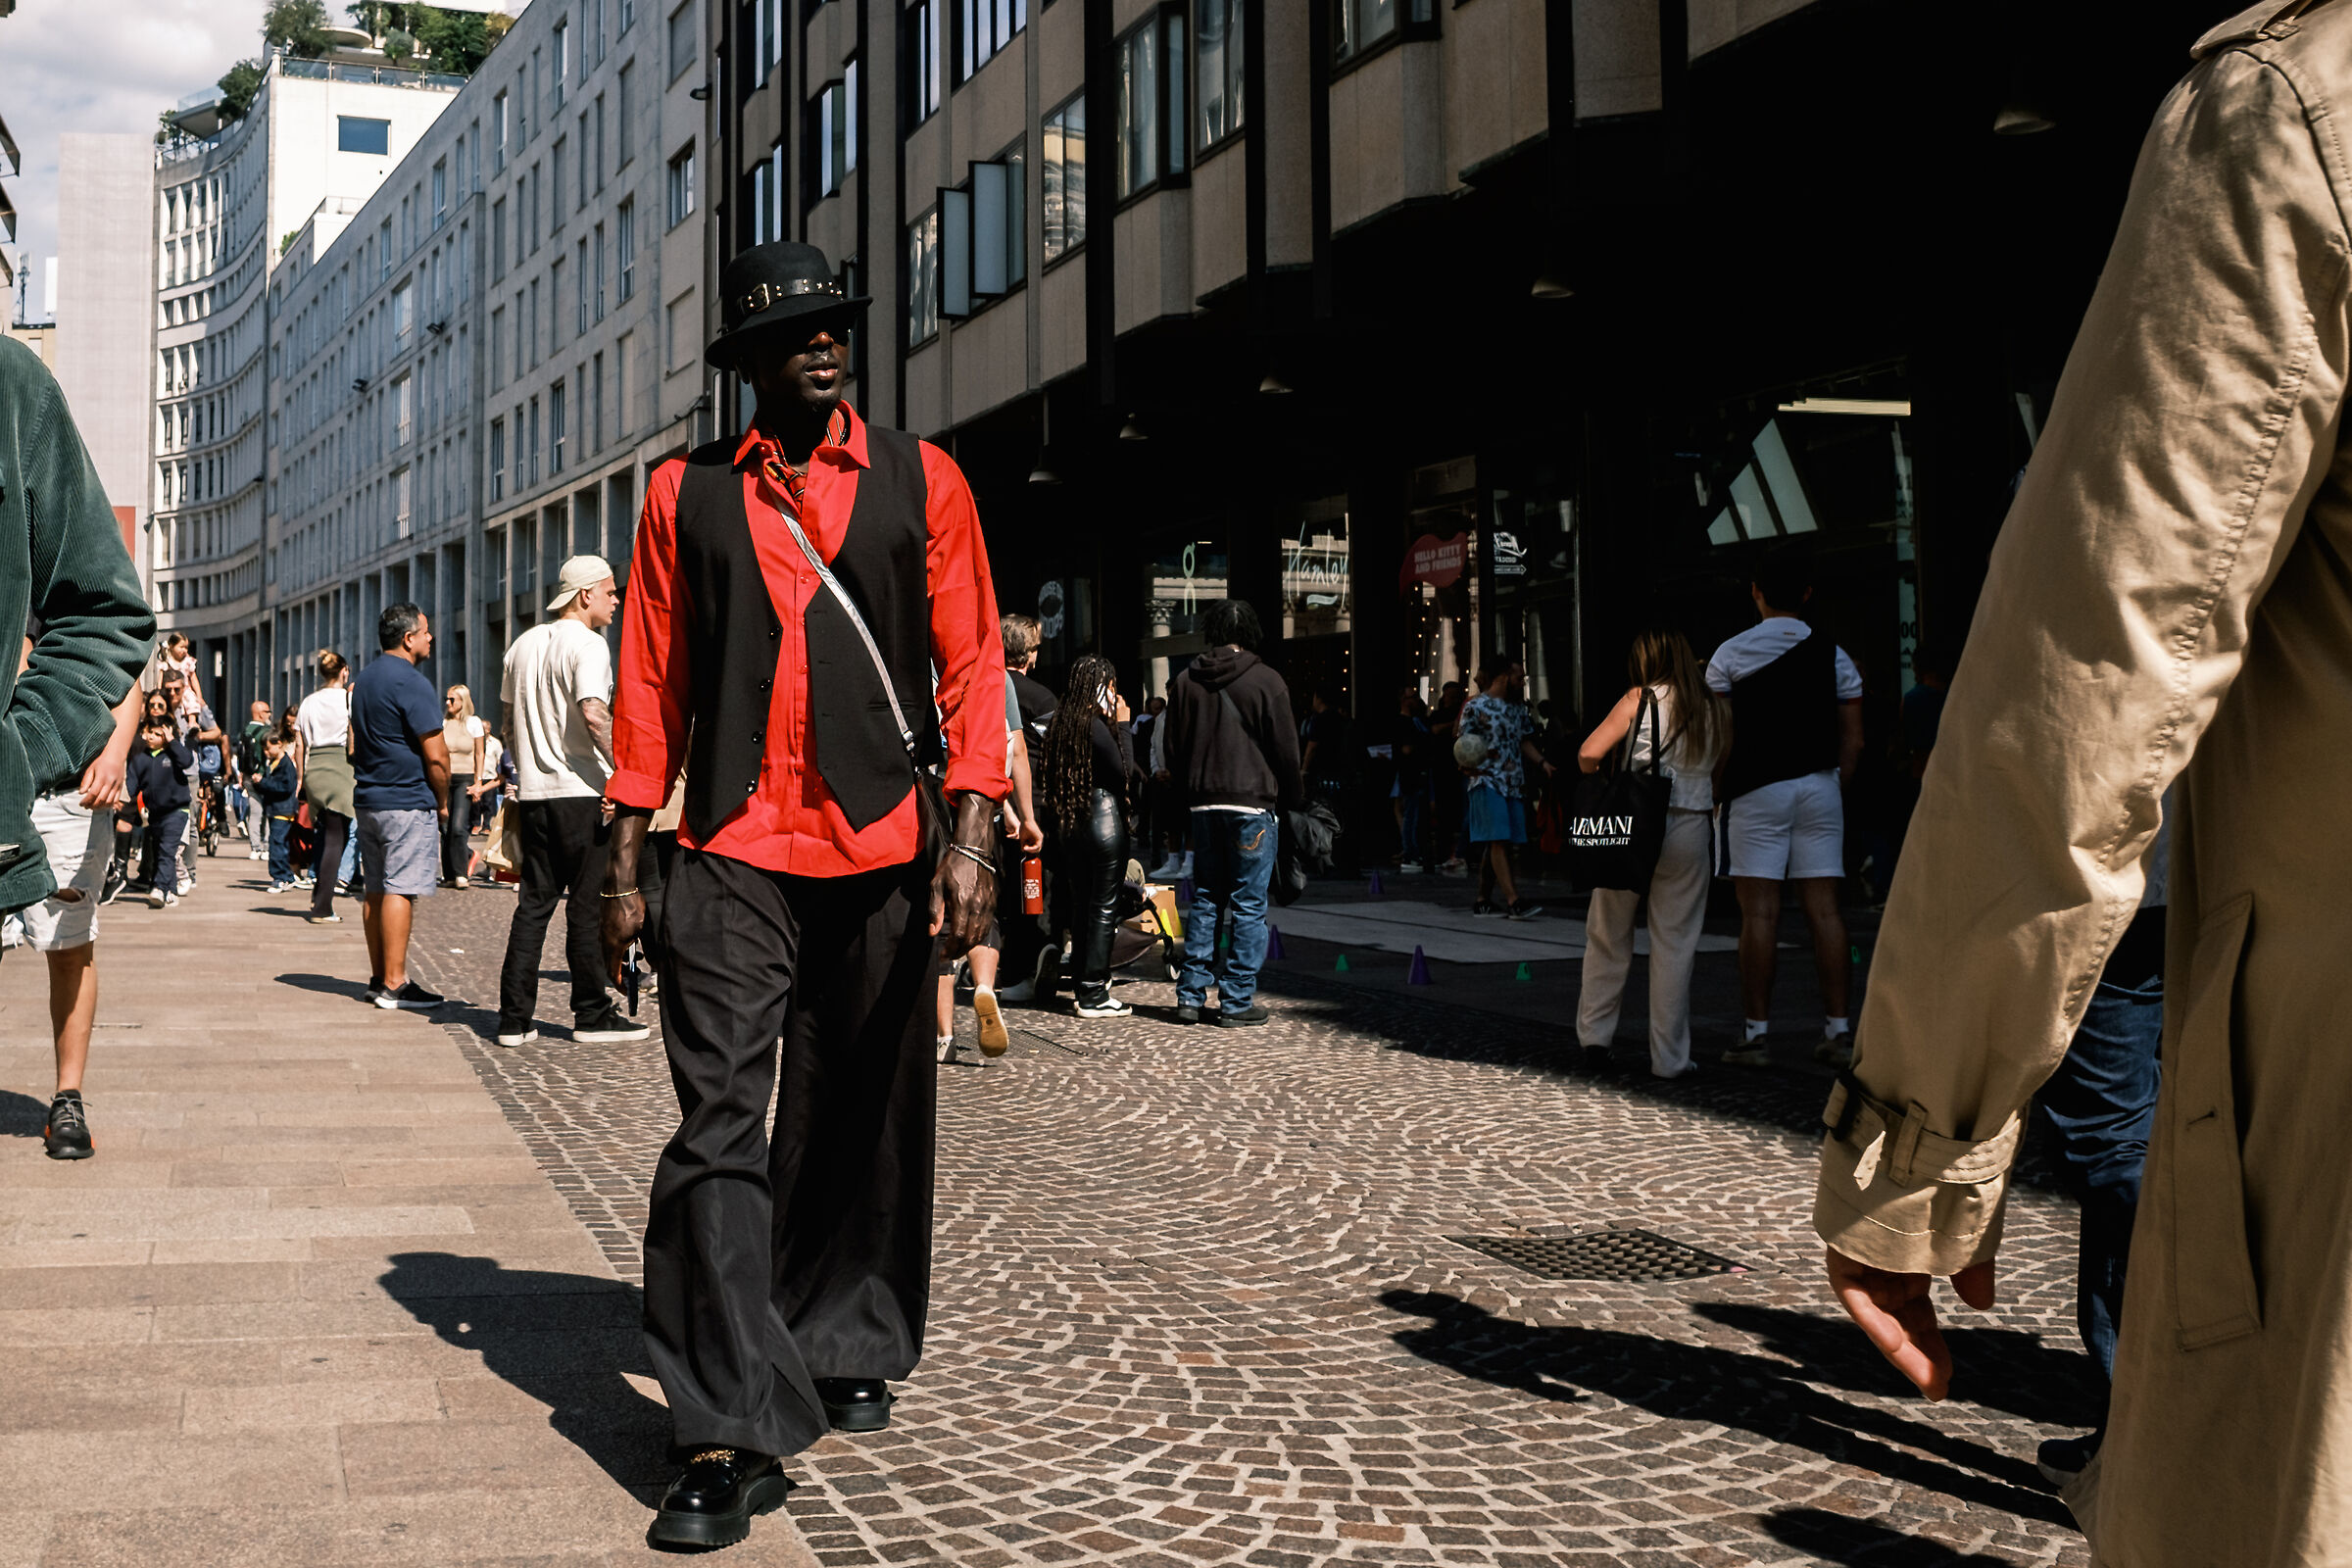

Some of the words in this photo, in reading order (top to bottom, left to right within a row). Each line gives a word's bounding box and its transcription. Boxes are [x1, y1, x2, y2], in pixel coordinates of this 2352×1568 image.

[1414, 549, 1436, 563] HELLO
[1438, 543, 1461, 559] KITTY
[1414, 562, 1431, 574] AND
[1432, 556, 1462, 571] FRIENDS
